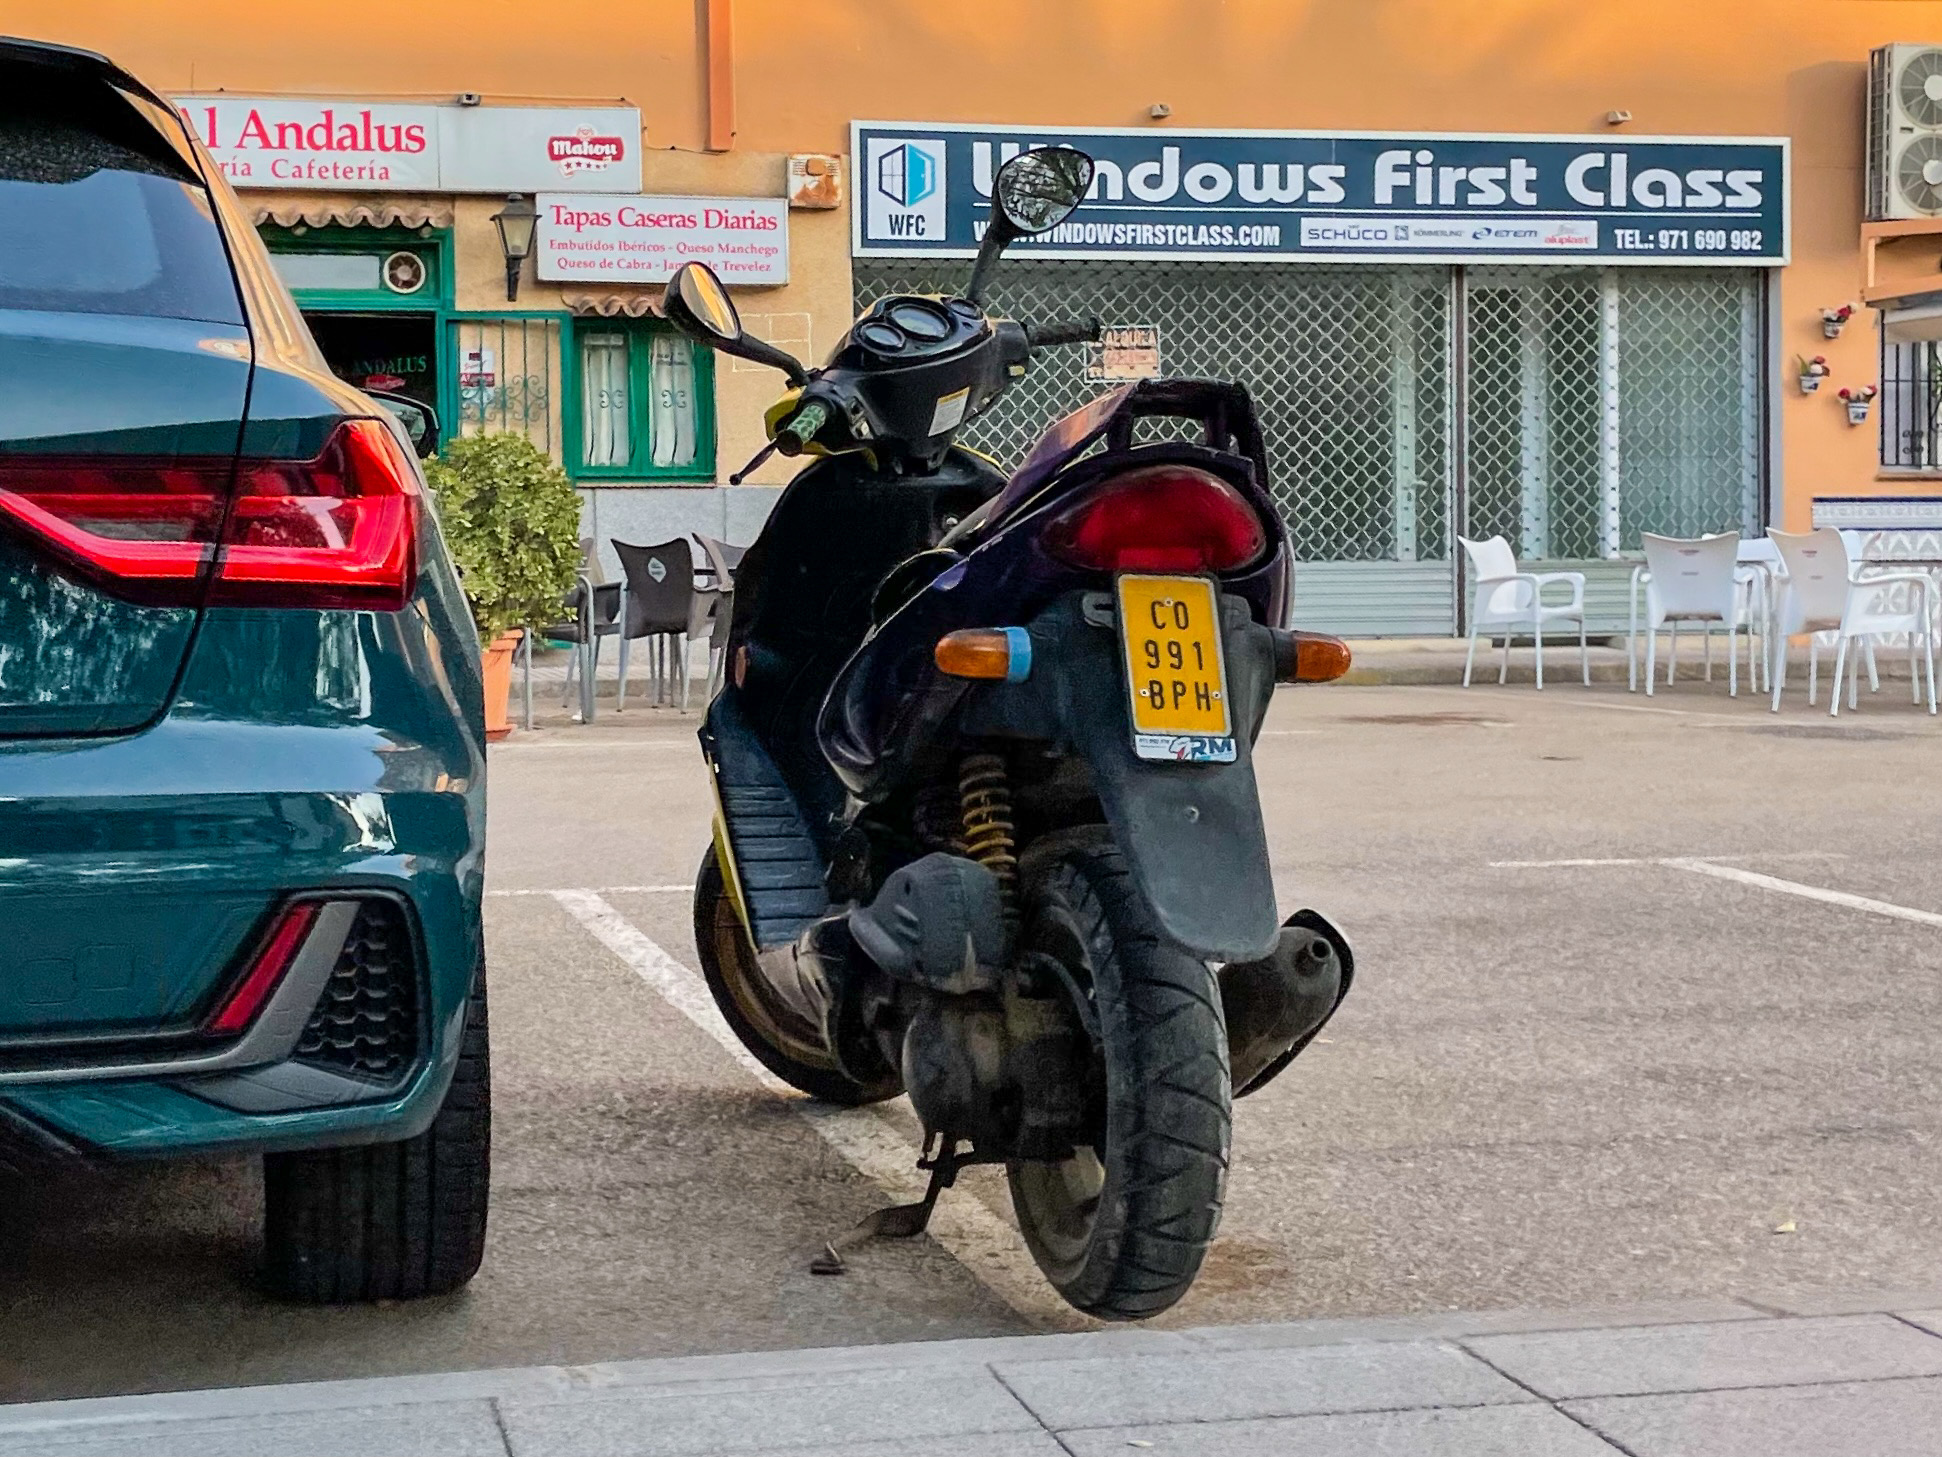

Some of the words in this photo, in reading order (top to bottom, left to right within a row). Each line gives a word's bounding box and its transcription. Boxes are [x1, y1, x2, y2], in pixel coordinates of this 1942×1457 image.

[181, 107, 221, 149] l
[235, 109, 426, 153] Andalus
[552, 140, 617, 155] Mahou
[271, 158, 390, 180] Cafetería
[1374, 150, 1538, 206] First
[1565, 152, 1763, 208] Class
[550, 205, 612, 232] Tapas
[617, 207, 698, 229] Caseras
[704, 209, 777, 230] Diarias
[889, 213, 926, 236] WFC
[549, 239, 615, 252] Embutidos
[618, 240, 666, 252] Ibéricos
[676, 242, 715, 254] Queso
[718, 243, 779, 257] Manchego
[1544, 235, 1589, 245] aluplast
[1614, 228, 1654, 249] TEL.:
[1658, 229, 1689, 250] 971
[1694, 229, 1726, 250] 690
[1730, 230, 1763, 250] 982
[557, 257, 596, 270] Queso
[599, 258, 614, 269] de
[617, 258, 652, 270] Cabra
[722, 260, 772, 272] Trevelez
[1144, 639, 1204, 671] 991
[1149, 679, 1211, 711] BPH
